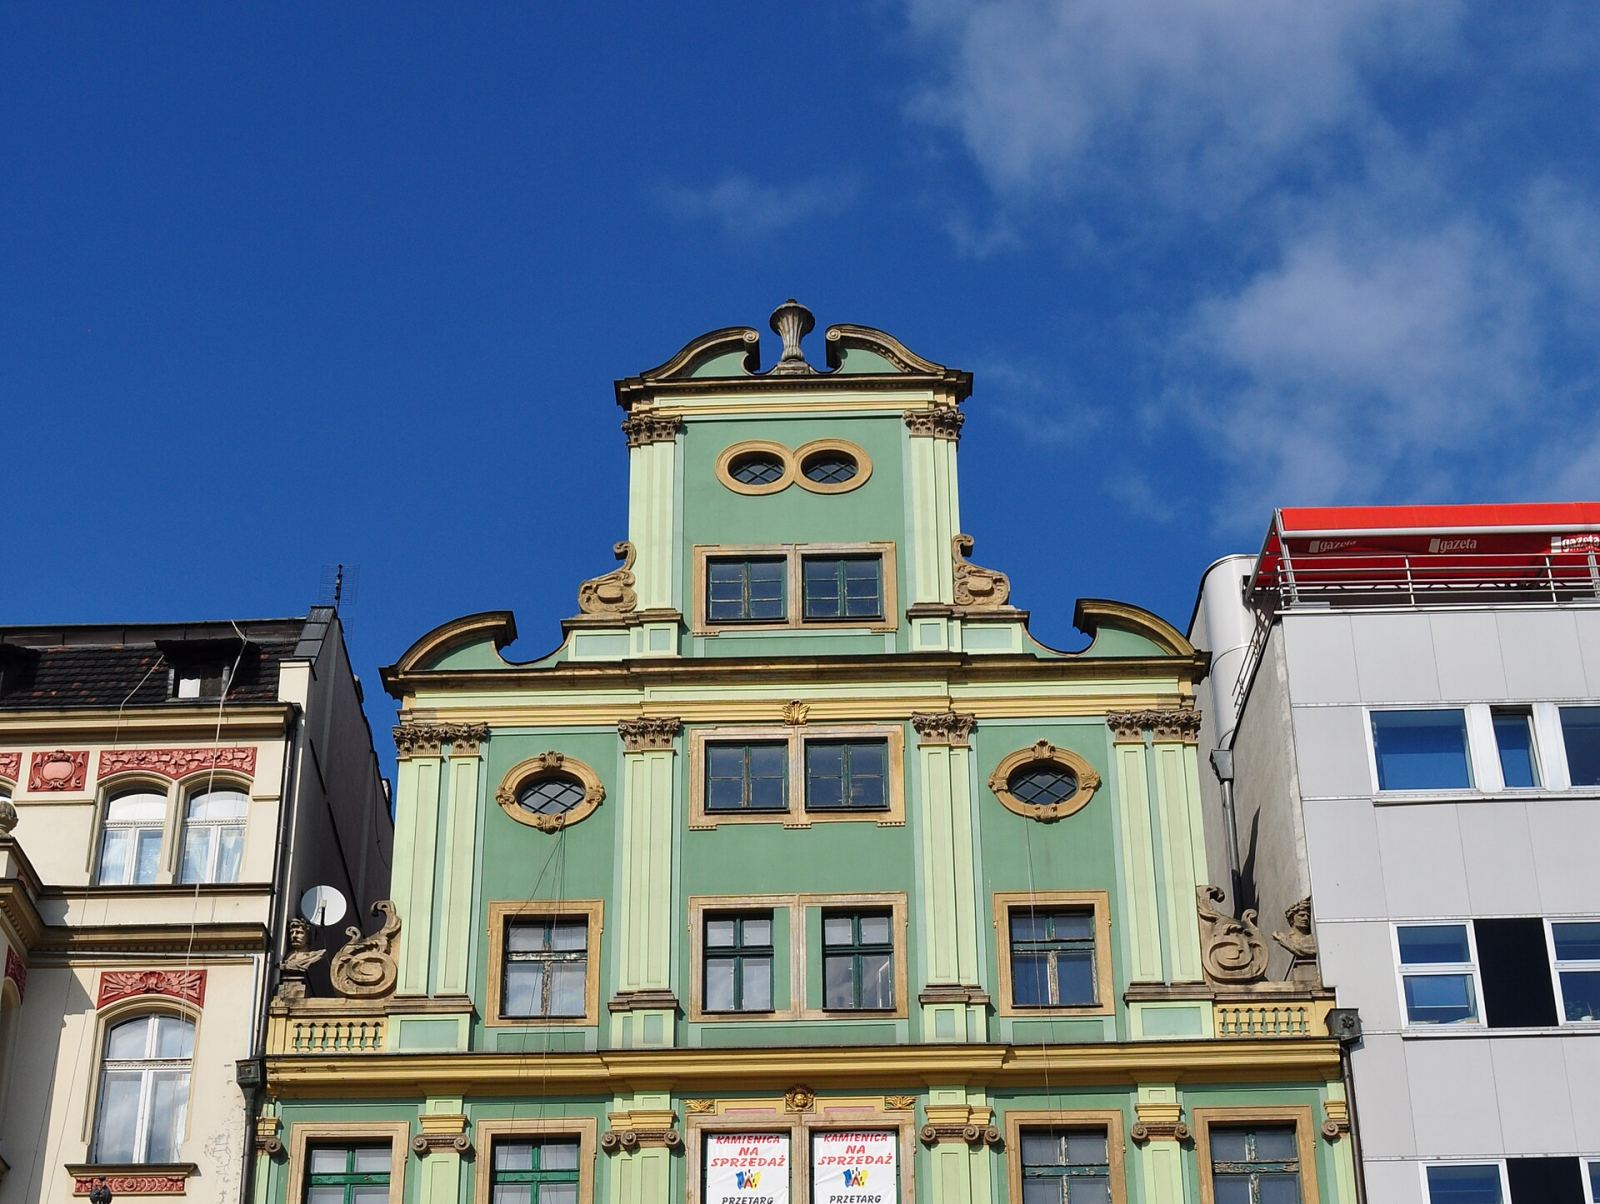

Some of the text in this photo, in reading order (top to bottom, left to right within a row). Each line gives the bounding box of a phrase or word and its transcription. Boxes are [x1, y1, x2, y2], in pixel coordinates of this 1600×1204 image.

[1440, 538, 1477, 553] gazeta
[716, 1136, 780, 1144] KAMIENICA
[824, 1134, 887, 1142] KAMIENICA
[738, 1147, 758, 1156] NA
[846, 1145, 865, 1154] NA
[711, 1155, 785, 1166] SPRZEDAŻ
[818, 1153, 892, 1165] SPRZEDAŻ
[722, 1197, 773, 1204] PRZETARG
[830, 1195, 881, 1204] PRZETARG
